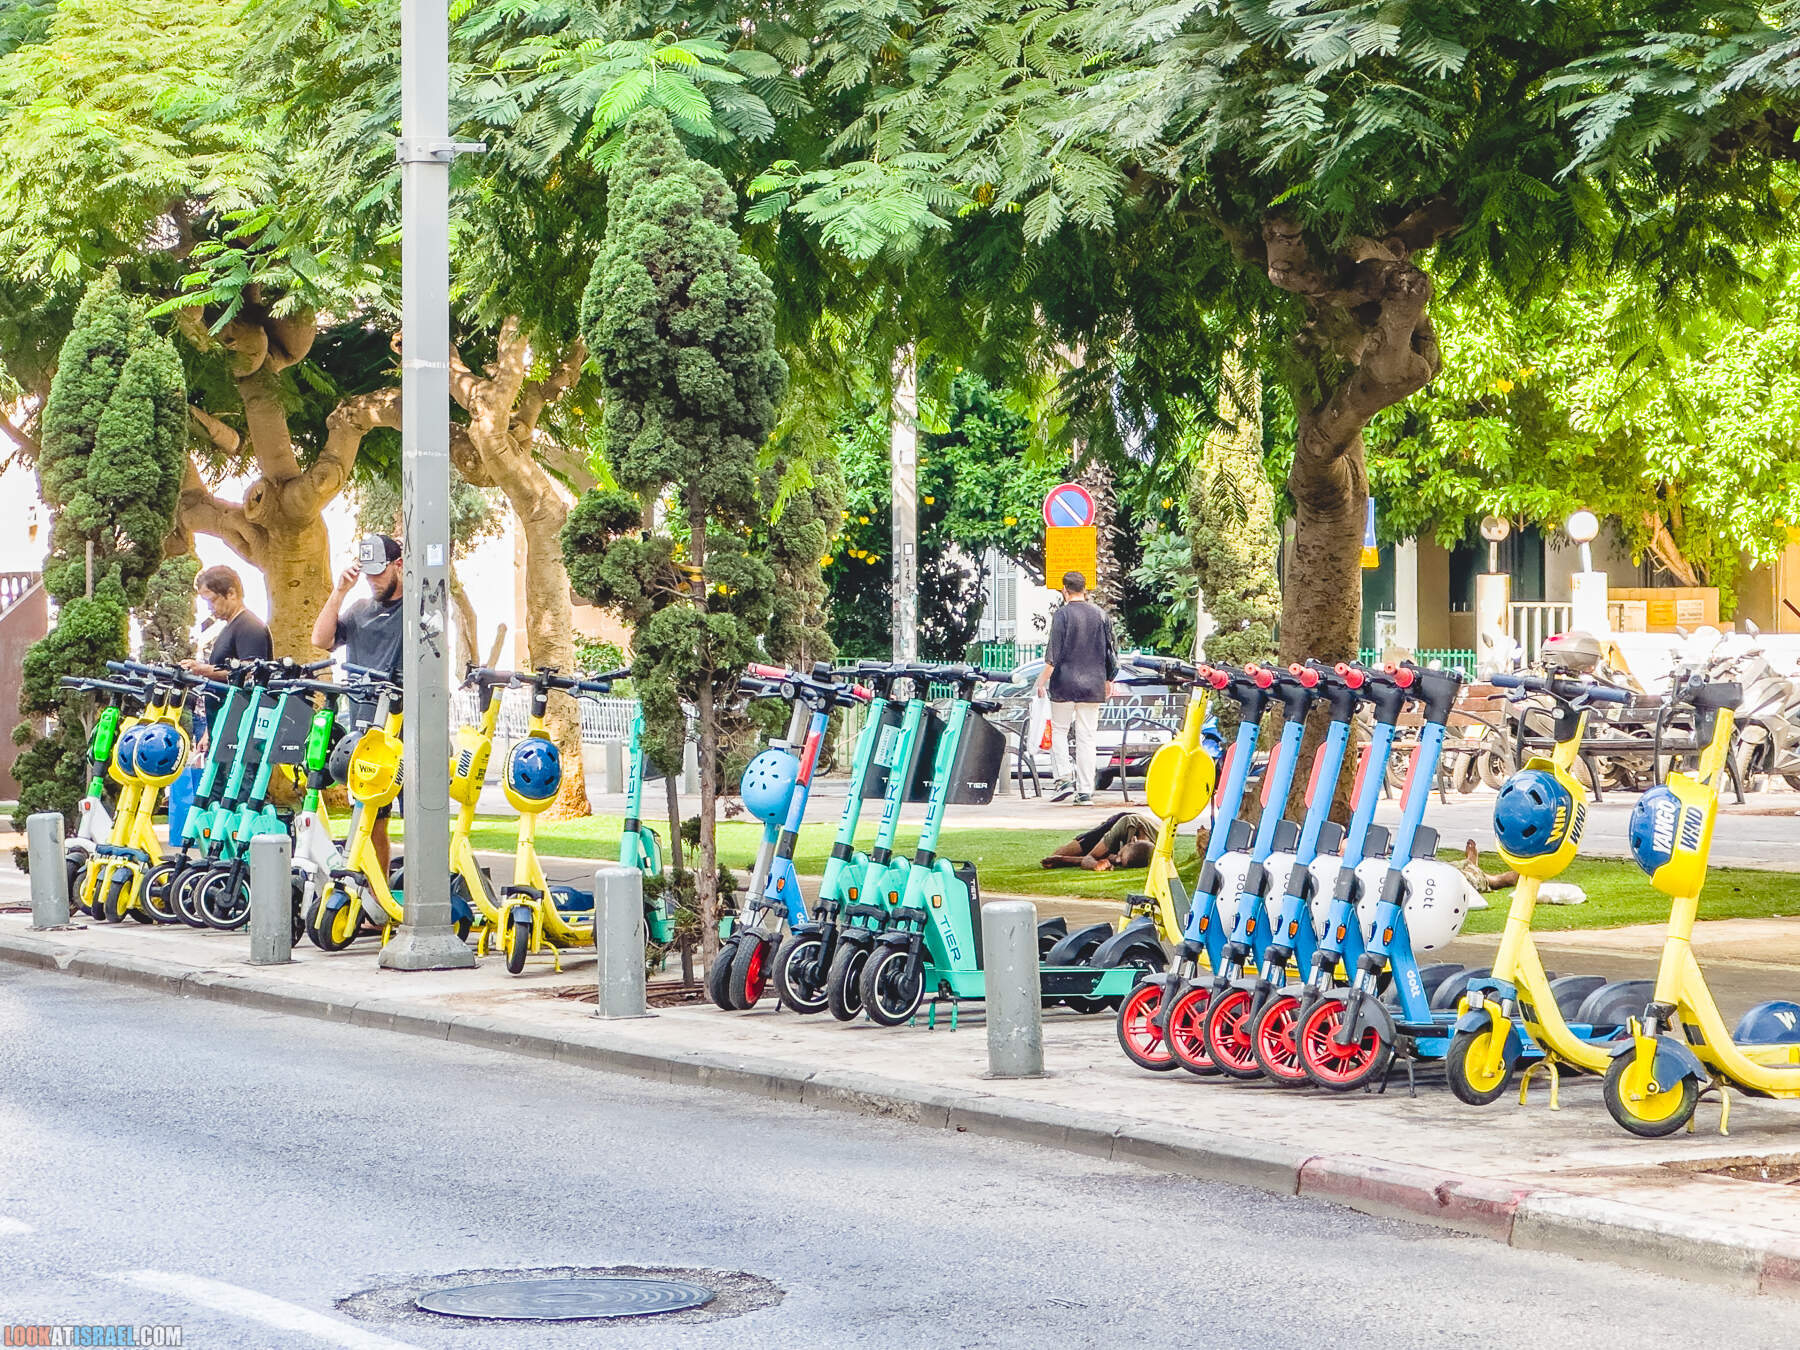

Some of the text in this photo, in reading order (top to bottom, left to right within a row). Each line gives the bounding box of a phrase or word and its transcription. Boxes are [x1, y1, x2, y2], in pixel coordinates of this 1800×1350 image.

[457, 748, 473, 778] WIND
[966, 781, 988, 789] TIER
[1570, 802, 1586, 845] WIND
[1652, 799, 1677, 854] YANGO
[1680, 805, 1704, 851] WIND
[969, 878, 977, 901] TIER
[1423, 878, 1436, 909] dott
[939, 914, 961, 962] TIER
[1407, 969, 1421, 999] dott
